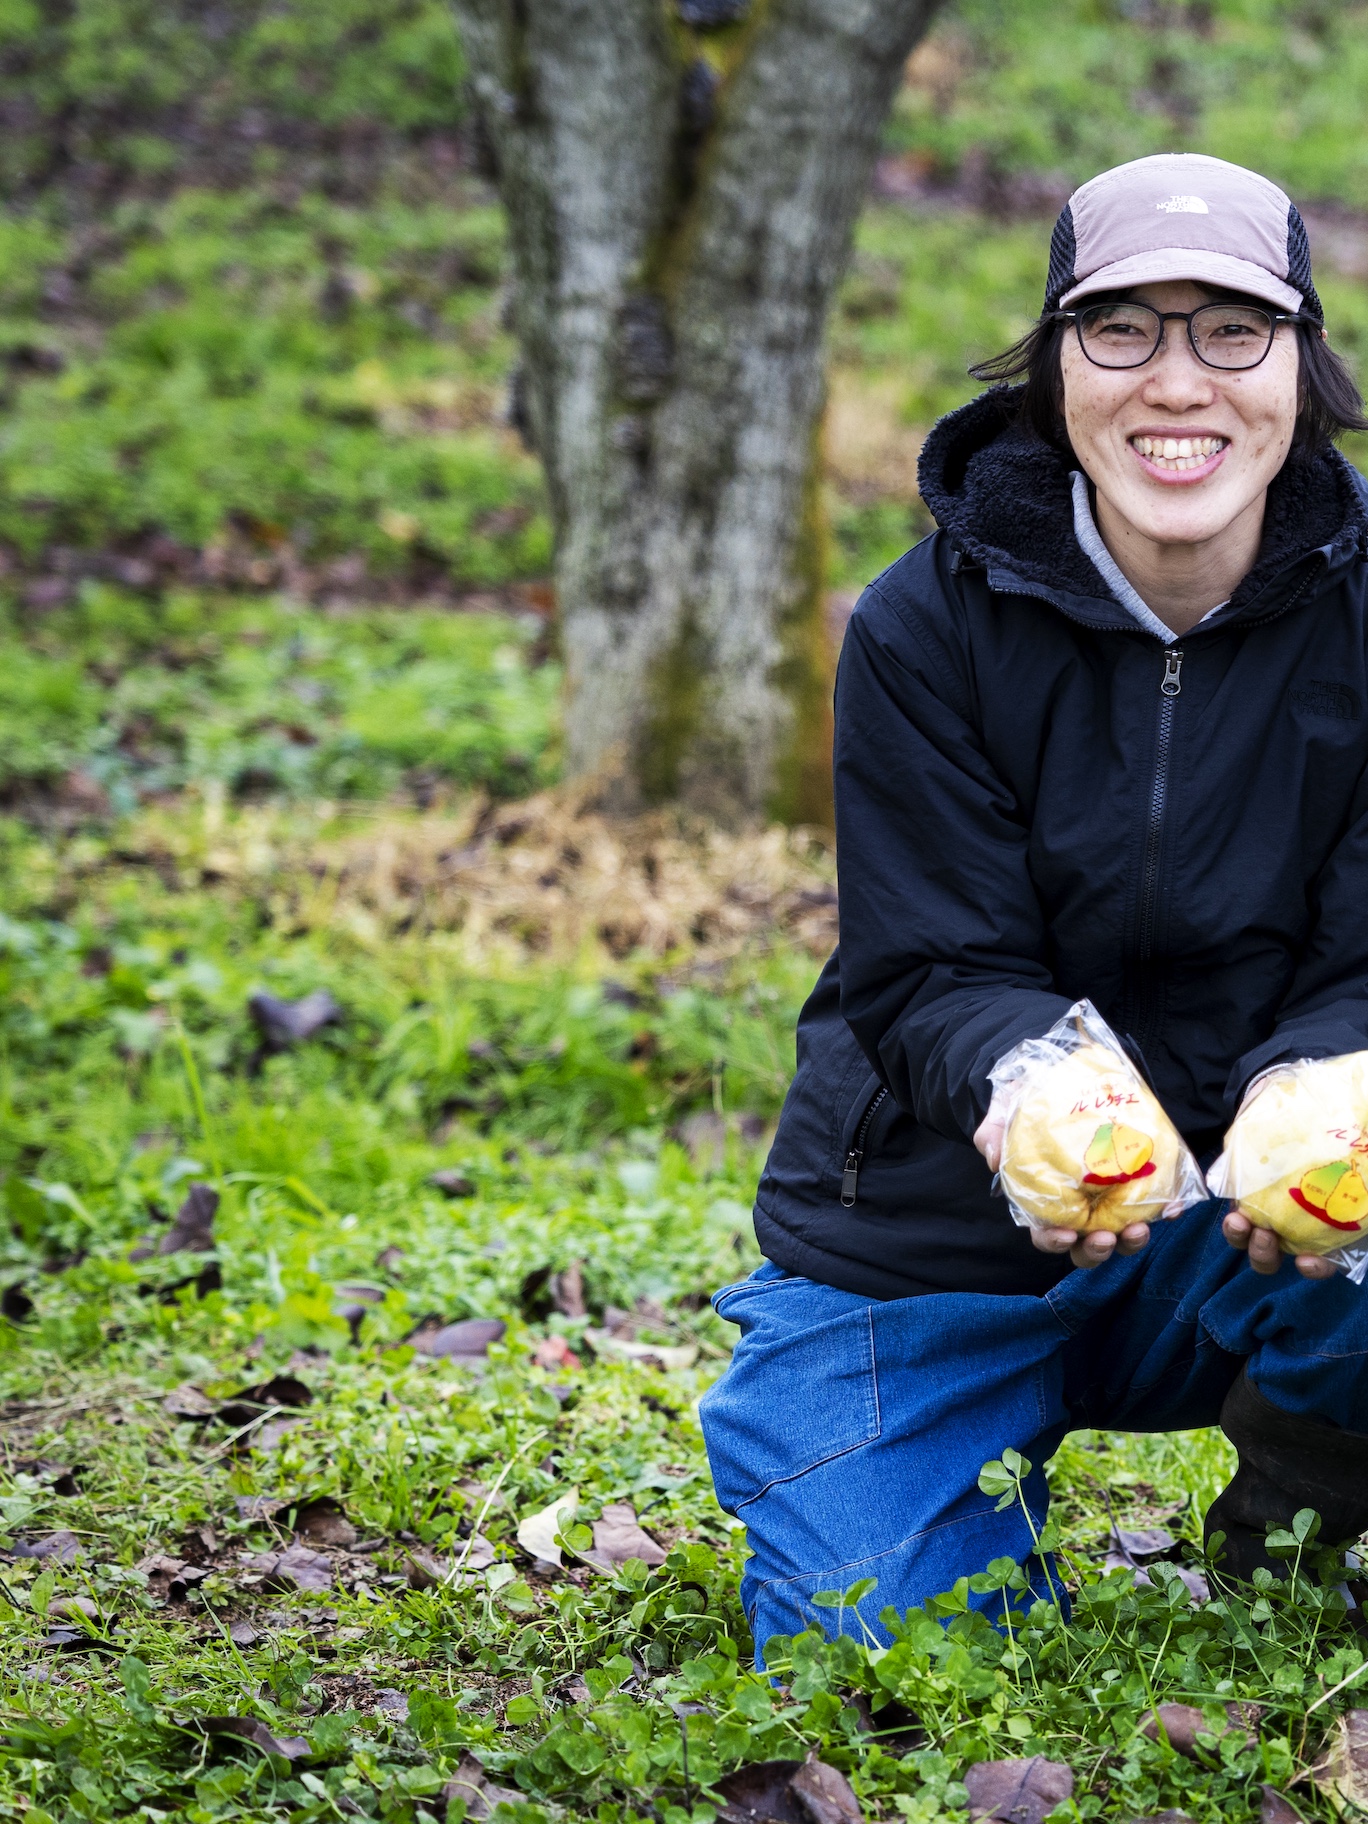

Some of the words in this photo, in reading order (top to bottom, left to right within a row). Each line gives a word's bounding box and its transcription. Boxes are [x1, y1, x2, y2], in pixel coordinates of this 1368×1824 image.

[1311, 680, 1339, 694] THE
[1288, 688, 1337, 706] NORTH
[1301, 703, 1338, 717] FACE
